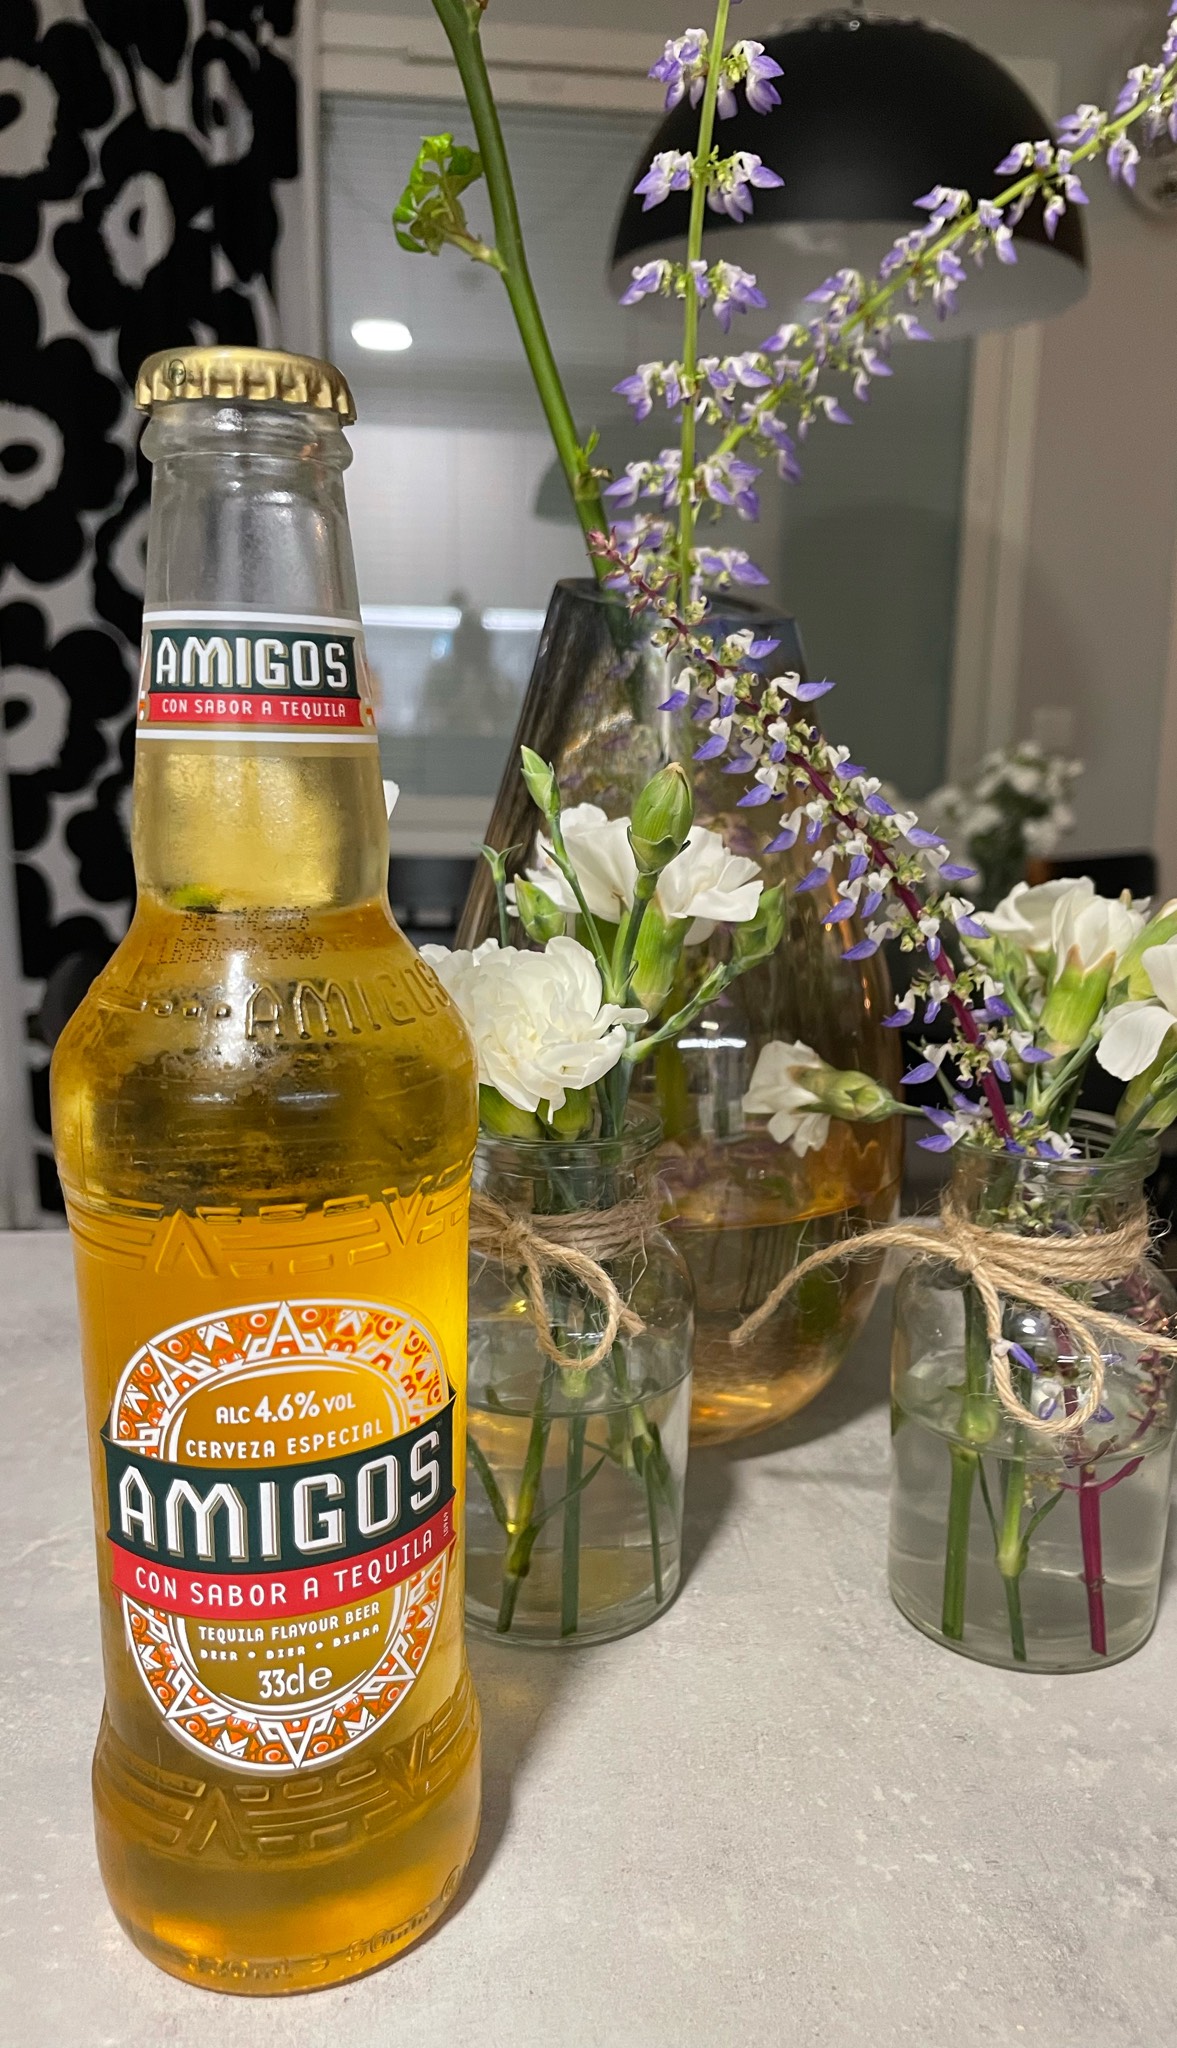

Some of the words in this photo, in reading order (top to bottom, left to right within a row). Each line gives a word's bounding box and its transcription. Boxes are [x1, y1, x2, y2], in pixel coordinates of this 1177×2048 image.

[156, 636, 349, 689] AMIGOS
[161, 698, 188, 713] CON
[194, 699, 253, 715] SABOR
[261, 700, 272, 715] A
[281, 700, 346, 718] TEQUILA
[215, 1405, 251, 1425] ALC
[254, 1389, 320, 1424] 4.6%
[323, 1392, 357, 1414] VOL
[185, 1439, 276, 1459] CERVEZA
[287, 1419, 384, 1455] ESPECIAL
[119, 1430, 441, 1563] AMIGOS
[135, 1565, 178, 1600] CON
[190, 1582, 287, 1607] SABOR
[303, 1576, 319, 1600] A
[333, 1529, 433, 1593] TEQUILA
[198, 1625, 264, 1645] TEQUILA
[271, 1615, 339, 1640] FLAVOUR
[345, 1601, 380, 1625] BEER
[200, 1649, 238, 1661] BEER
[266, 1645, 306, 1660] BIER
[333, 1623, 380, 1648] BIRRA
